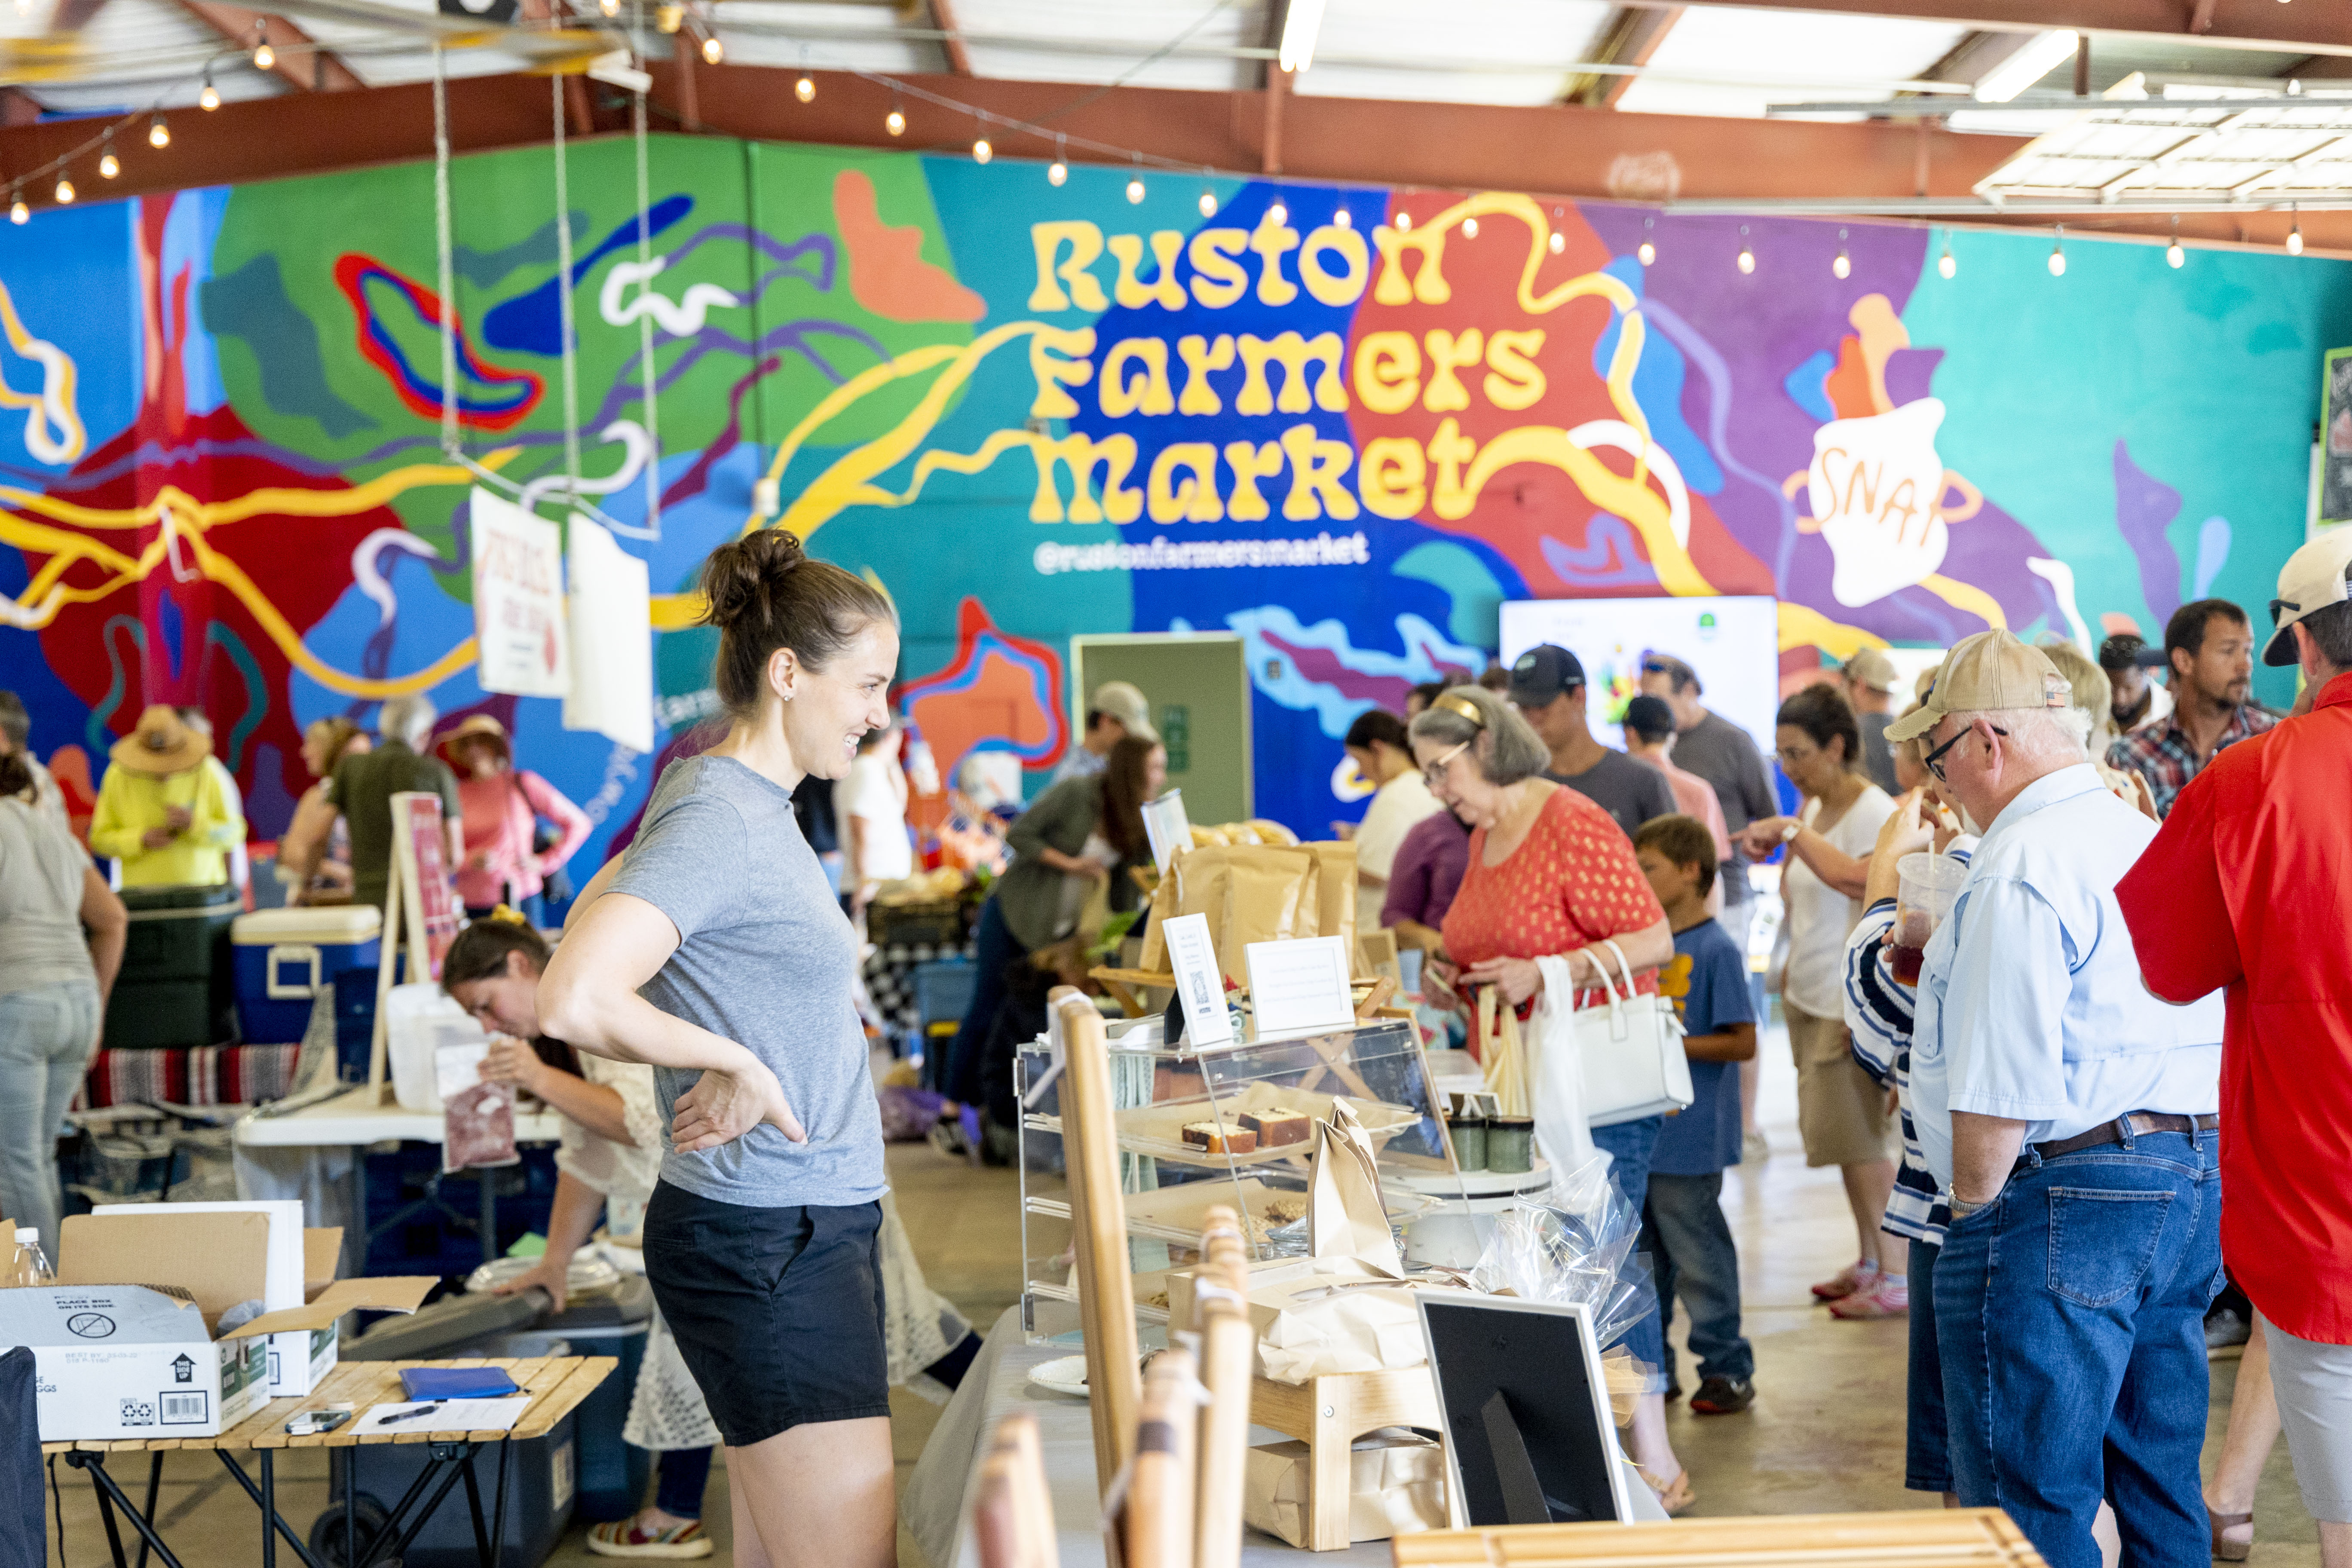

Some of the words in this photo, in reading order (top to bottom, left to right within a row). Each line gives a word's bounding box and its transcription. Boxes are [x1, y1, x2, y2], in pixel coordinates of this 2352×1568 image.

[1028, 211, 1452, 312] Ruston
[1029, 325, 1547, 418] Farmers
[1029, 418, 1477, 524] Market
